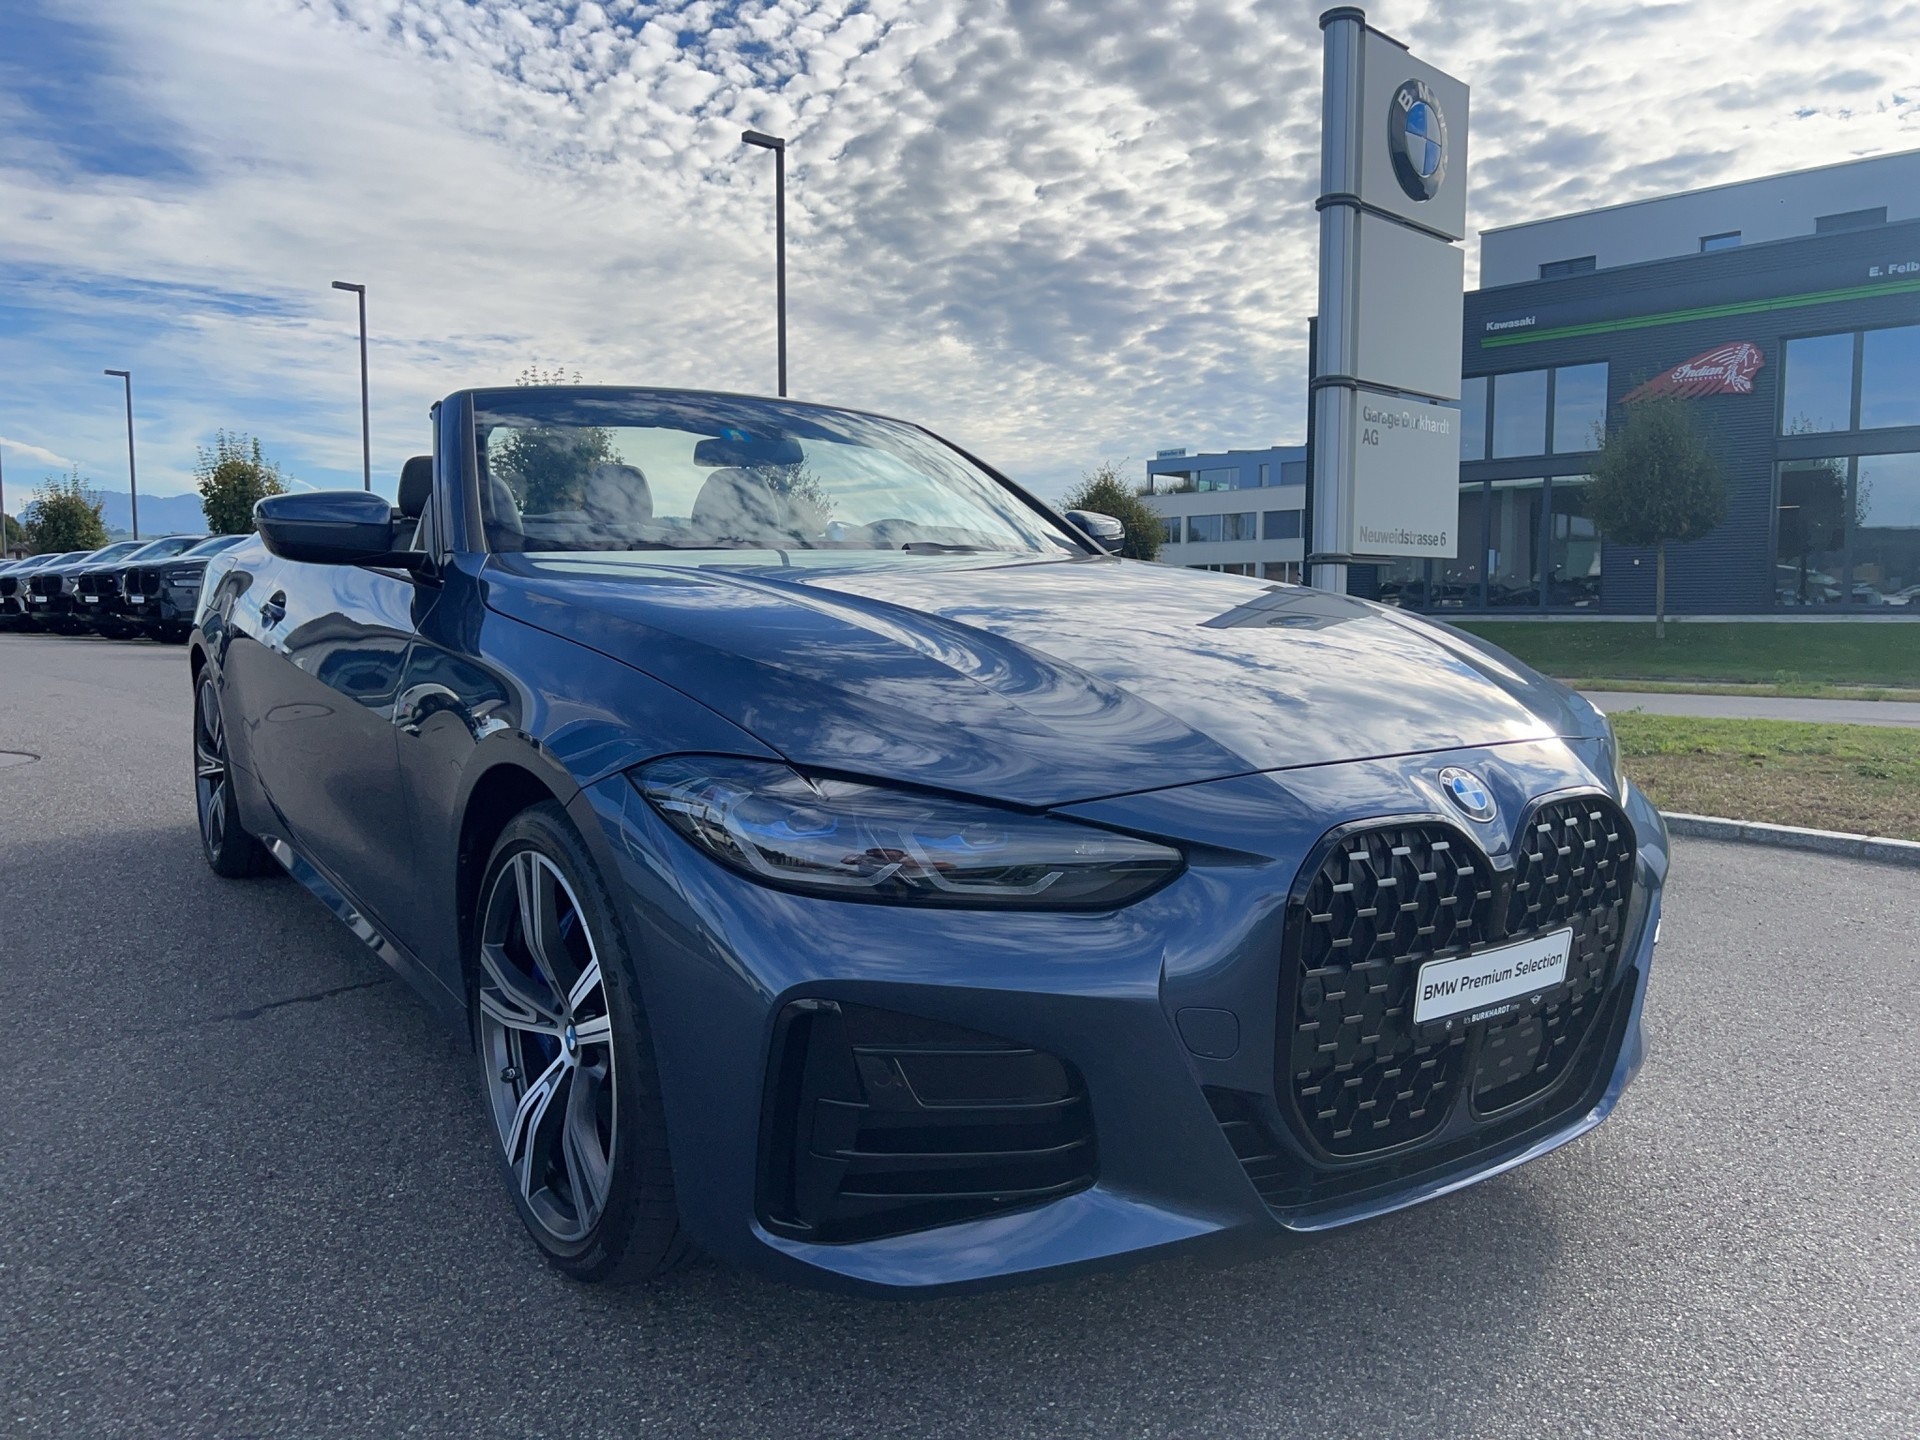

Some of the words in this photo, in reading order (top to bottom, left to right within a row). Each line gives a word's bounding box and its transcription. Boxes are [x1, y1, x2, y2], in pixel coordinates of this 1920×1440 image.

[1869, 266, 1883, 277] E.
[1486, 315, 1536, 331] Kawasaki
[1671, 364, 1724, 380] Indian
[1363, 406, 1400, 429] Garage
[1401, 411, 1450, 434] Burkhardt
[1362, 428, 1378, 446] AG
[1360, 526, 1438, 547] Neuweidstrasse
[1440, 532, 1447, 547] 6
[1423, 979, 1458, 1001] BMW
[1460, 969, 1512, 991] Premium
[1515, 953, 1562, 976] Selection
[1472, 1005, 1510, 1022] BURKHARDT
